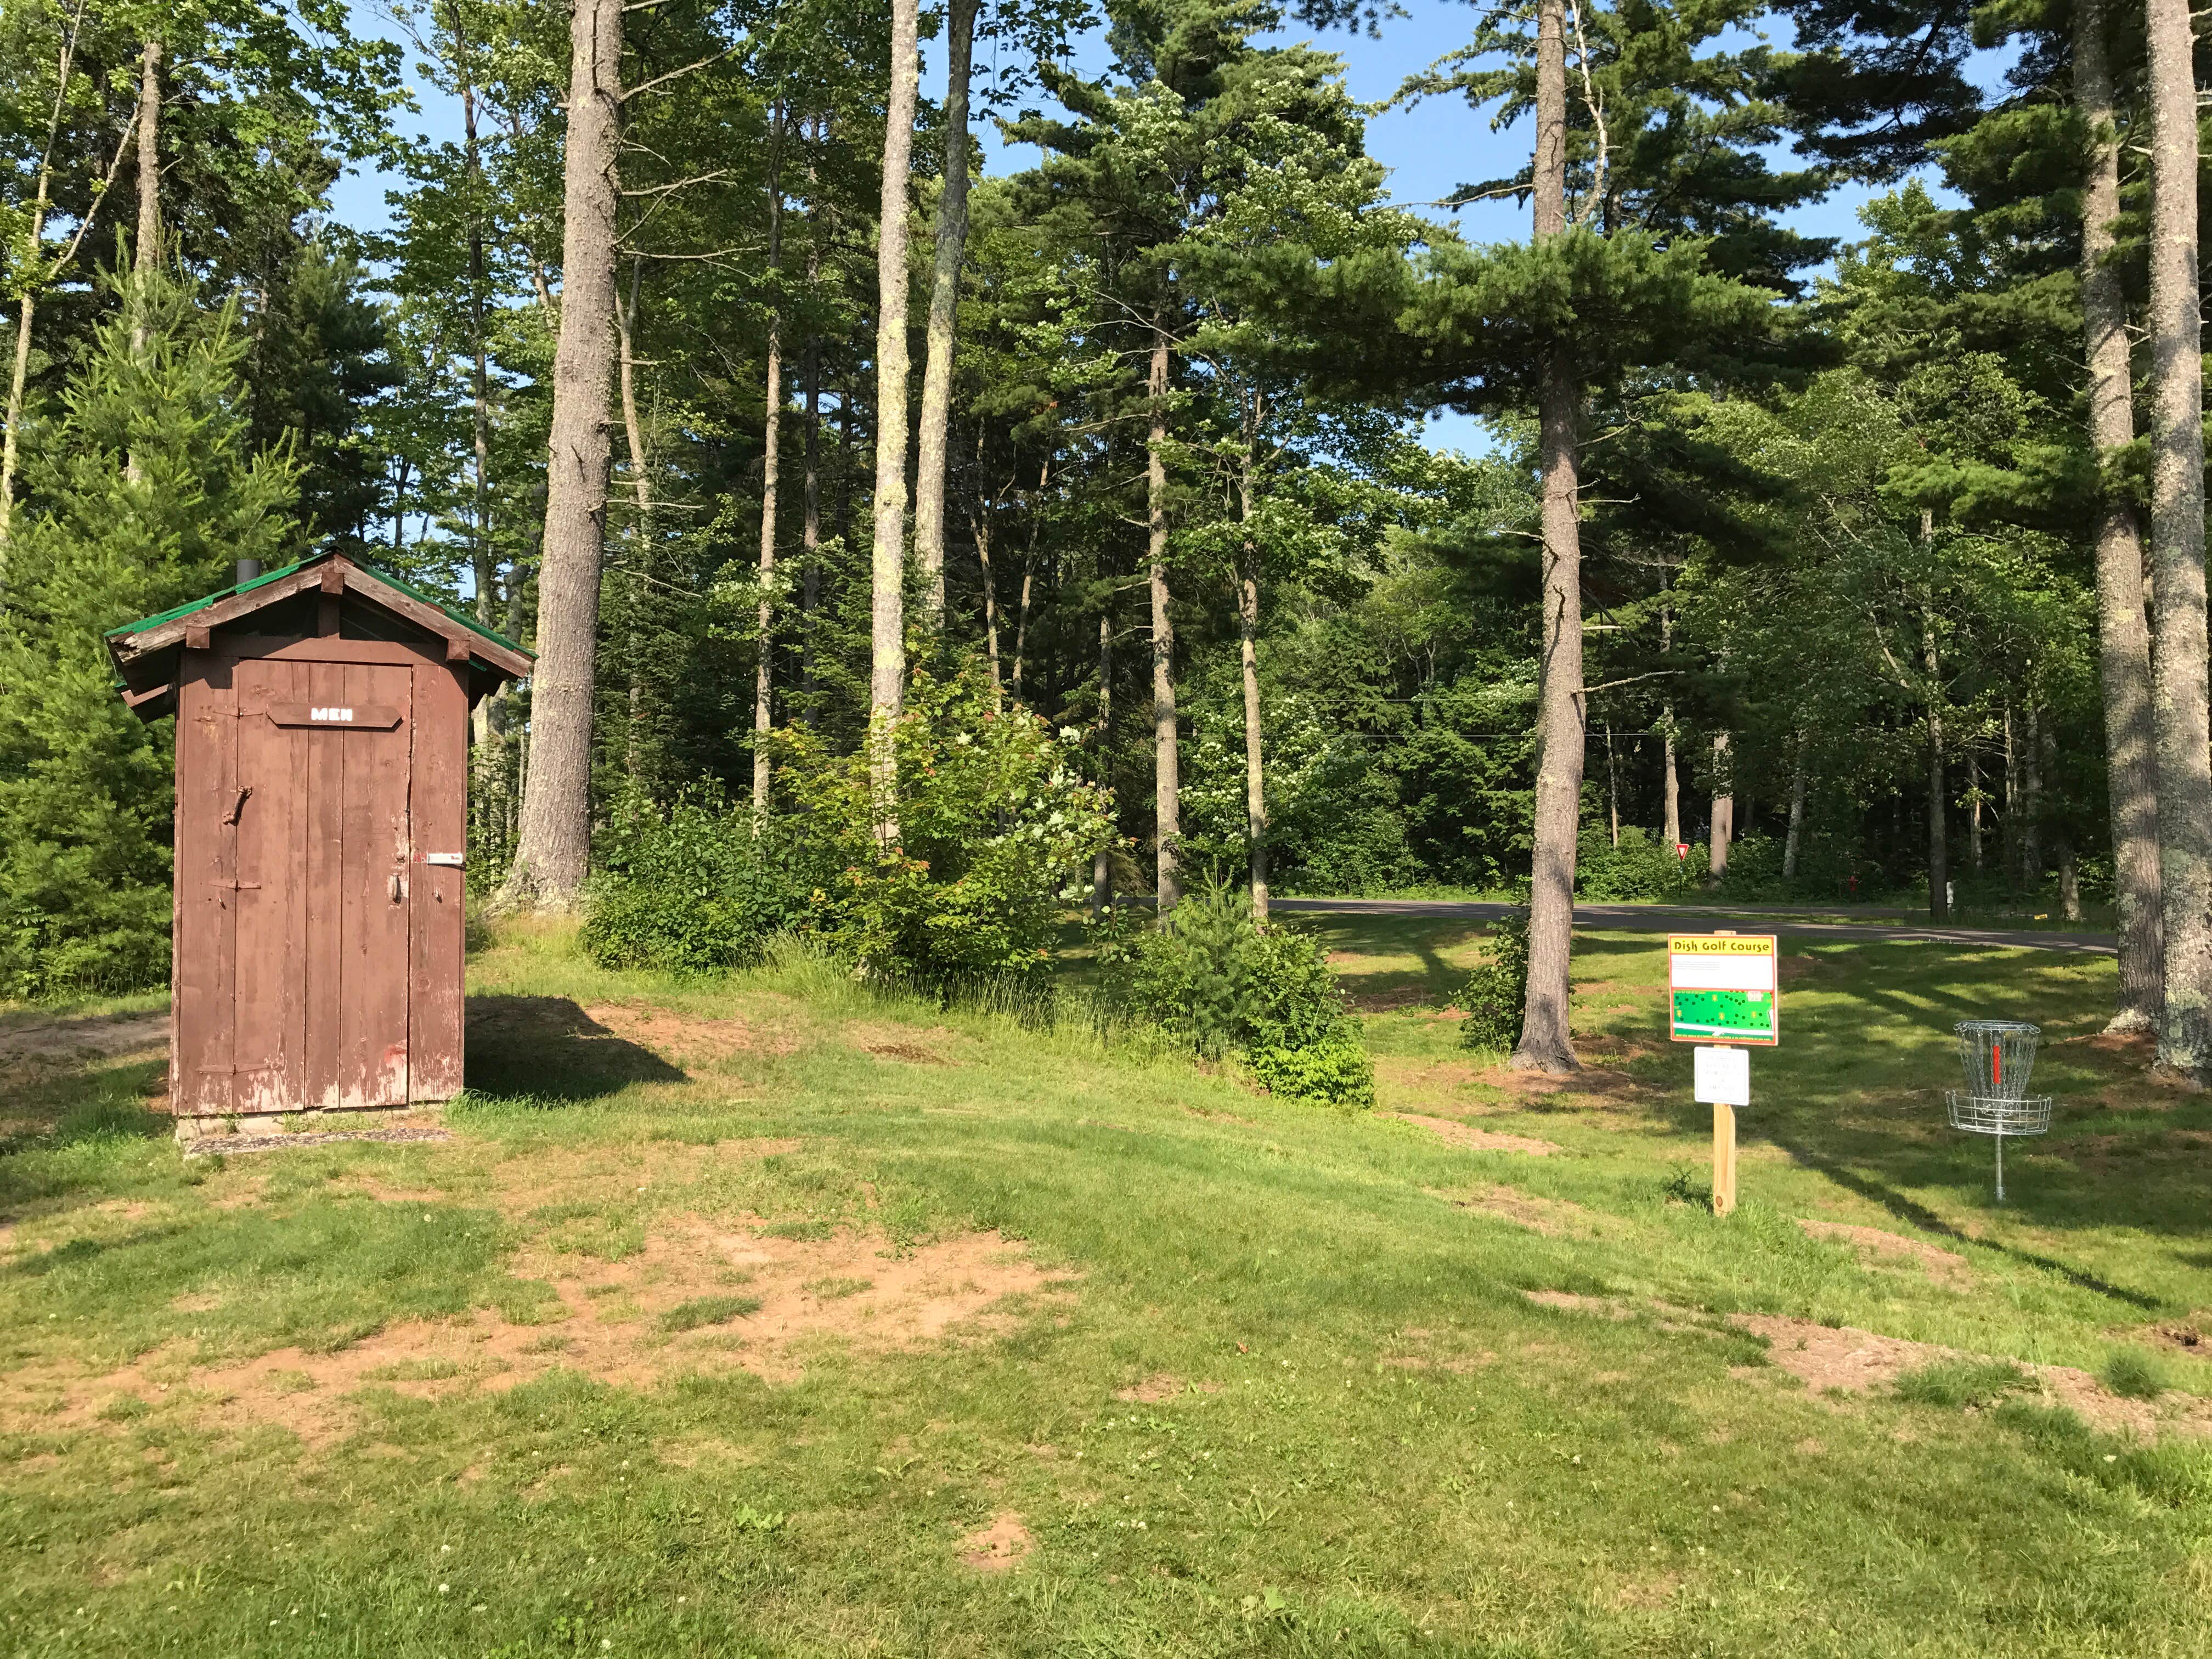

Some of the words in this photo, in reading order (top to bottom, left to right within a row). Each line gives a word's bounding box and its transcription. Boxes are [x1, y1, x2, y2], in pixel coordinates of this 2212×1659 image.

[311, 708, 353, 721] MEN
[1674, 940, 1697, 951] Disk
[1702, 941, 1726, 950] Golf
[1731, 943, 1770, 952] Course
